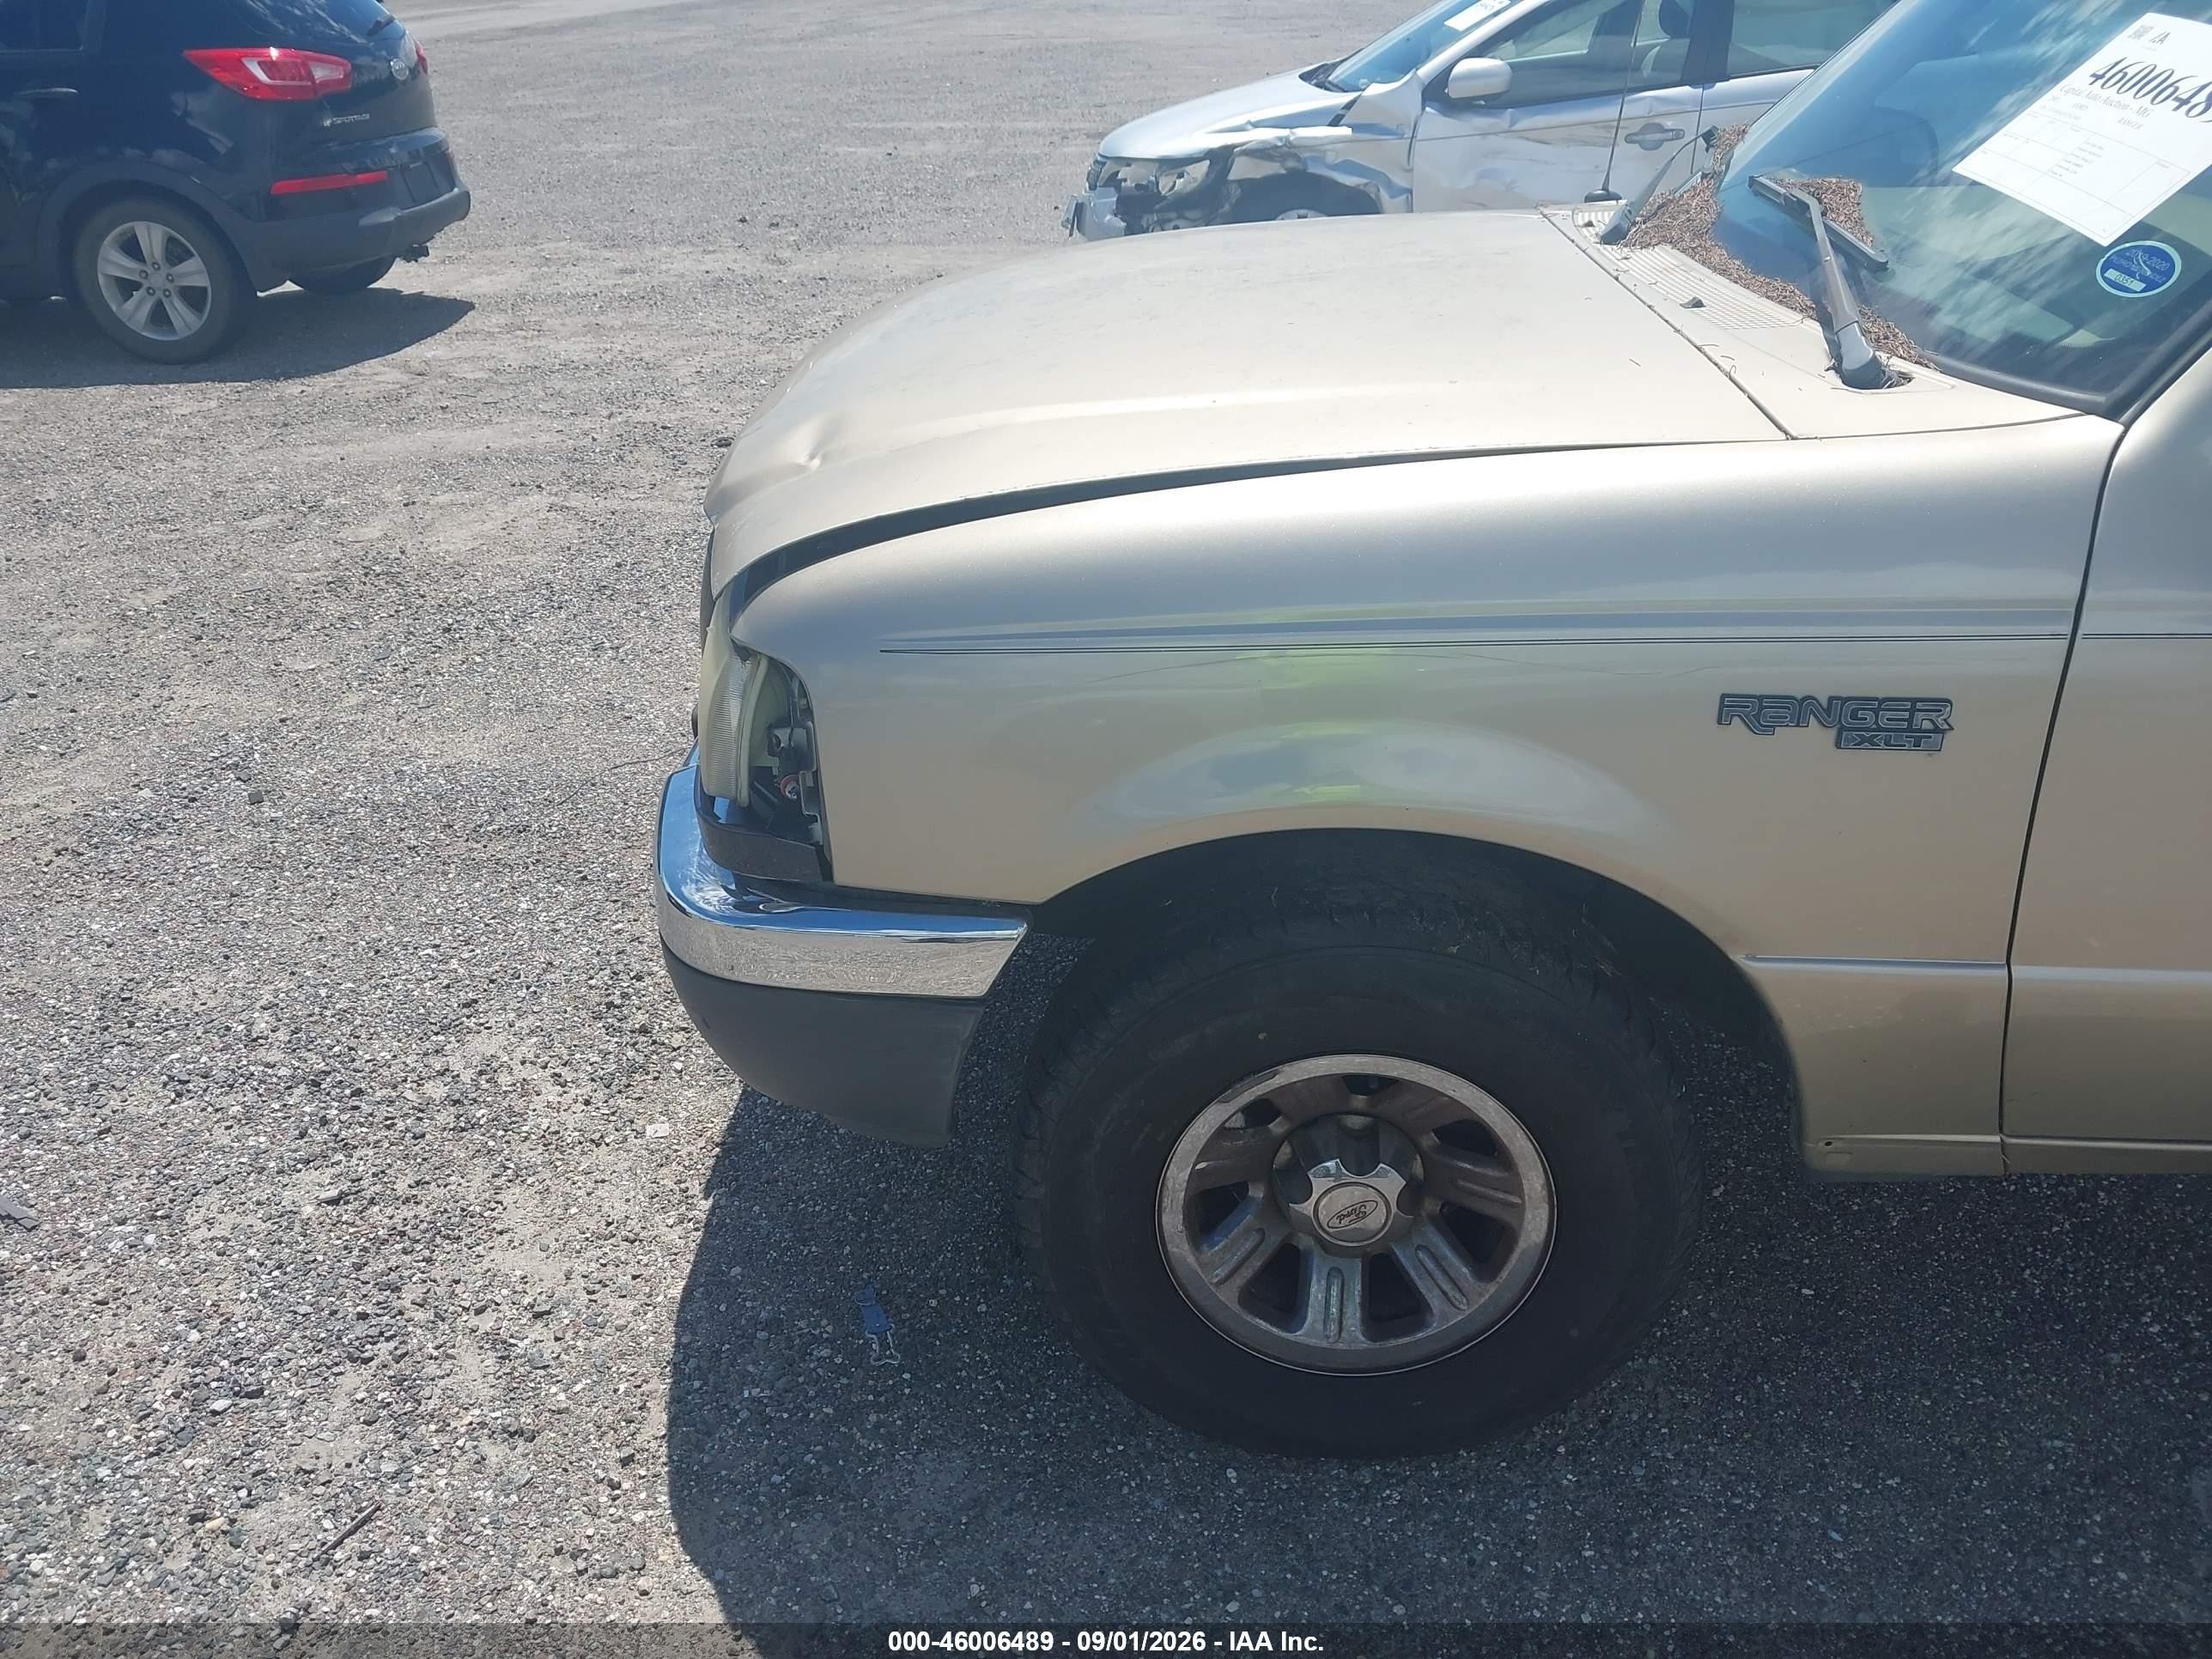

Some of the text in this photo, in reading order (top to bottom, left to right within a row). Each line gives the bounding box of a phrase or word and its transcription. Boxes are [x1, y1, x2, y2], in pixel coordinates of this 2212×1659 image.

[2088, 57, 2212, 123] 4600648
[1717, 694, 1954, 735] RANGER
[1849, 732, 1934, 749] XLT
